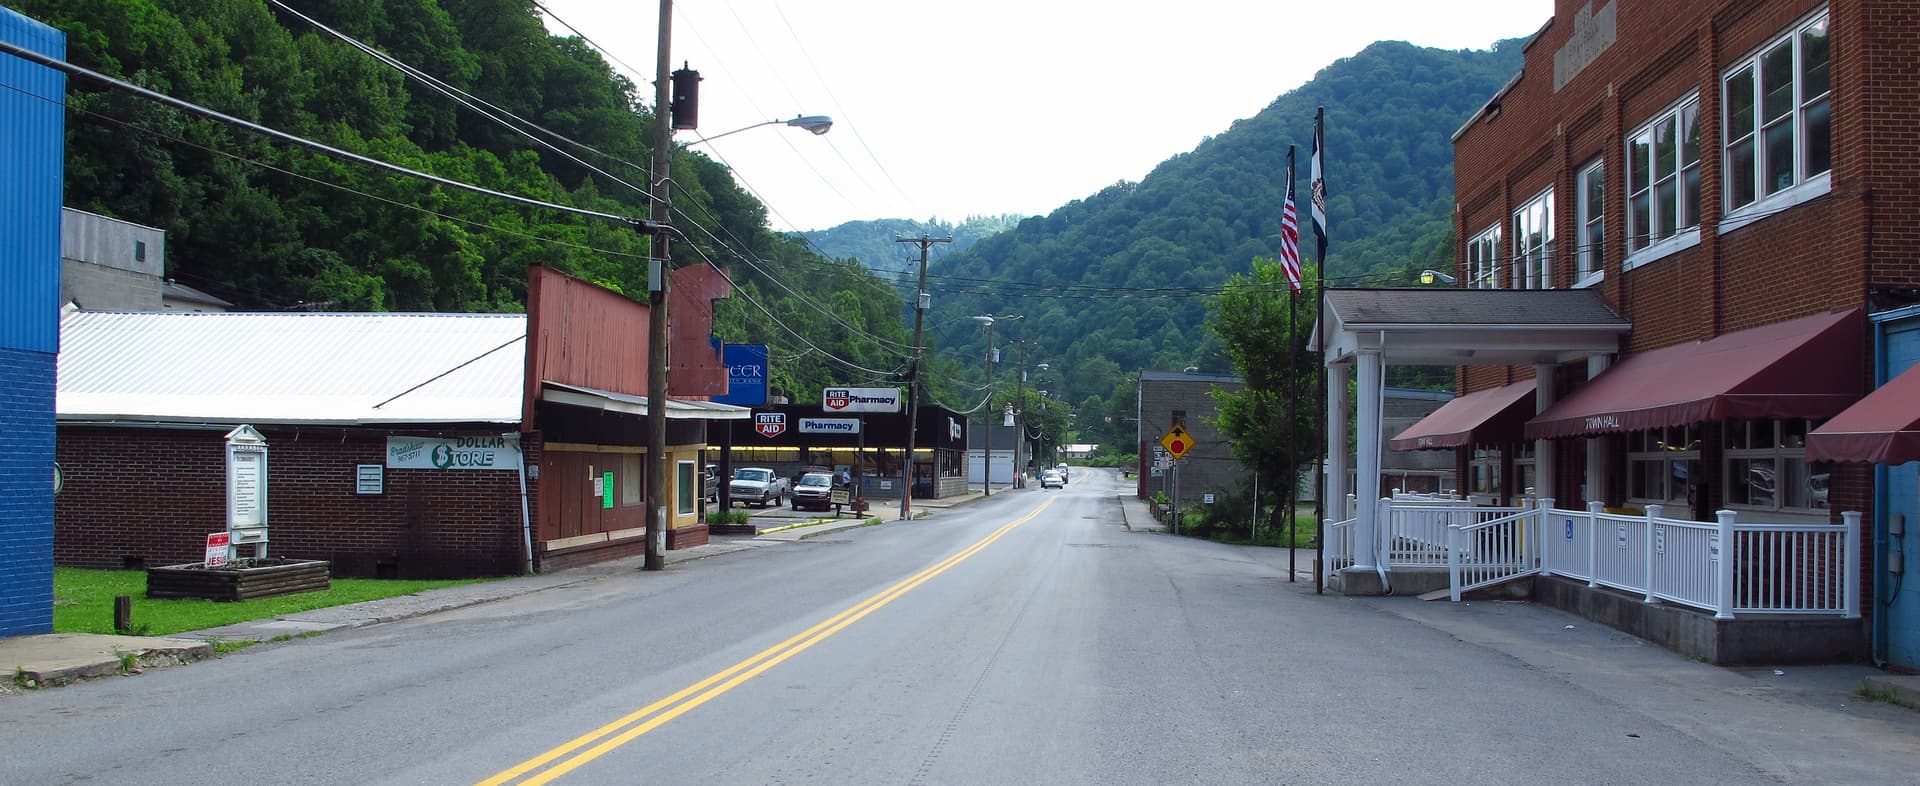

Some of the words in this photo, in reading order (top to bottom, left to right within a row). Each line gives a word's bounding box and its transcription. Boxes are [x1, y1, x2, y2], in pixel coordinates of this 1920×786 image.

[830, 399, 845, 407] AID
[849, 395, 896, 408] Pharmacy
[760, 415, 781, 423] RITE
[1585, 417, 1603, 430] TOWN
[1603, 416, 1620, 428] HALL
[762, 424, 780, 433] AID
[805, 421, 853, 431] Pharmacy
[456, 437, 505, 449] DOLLAR
